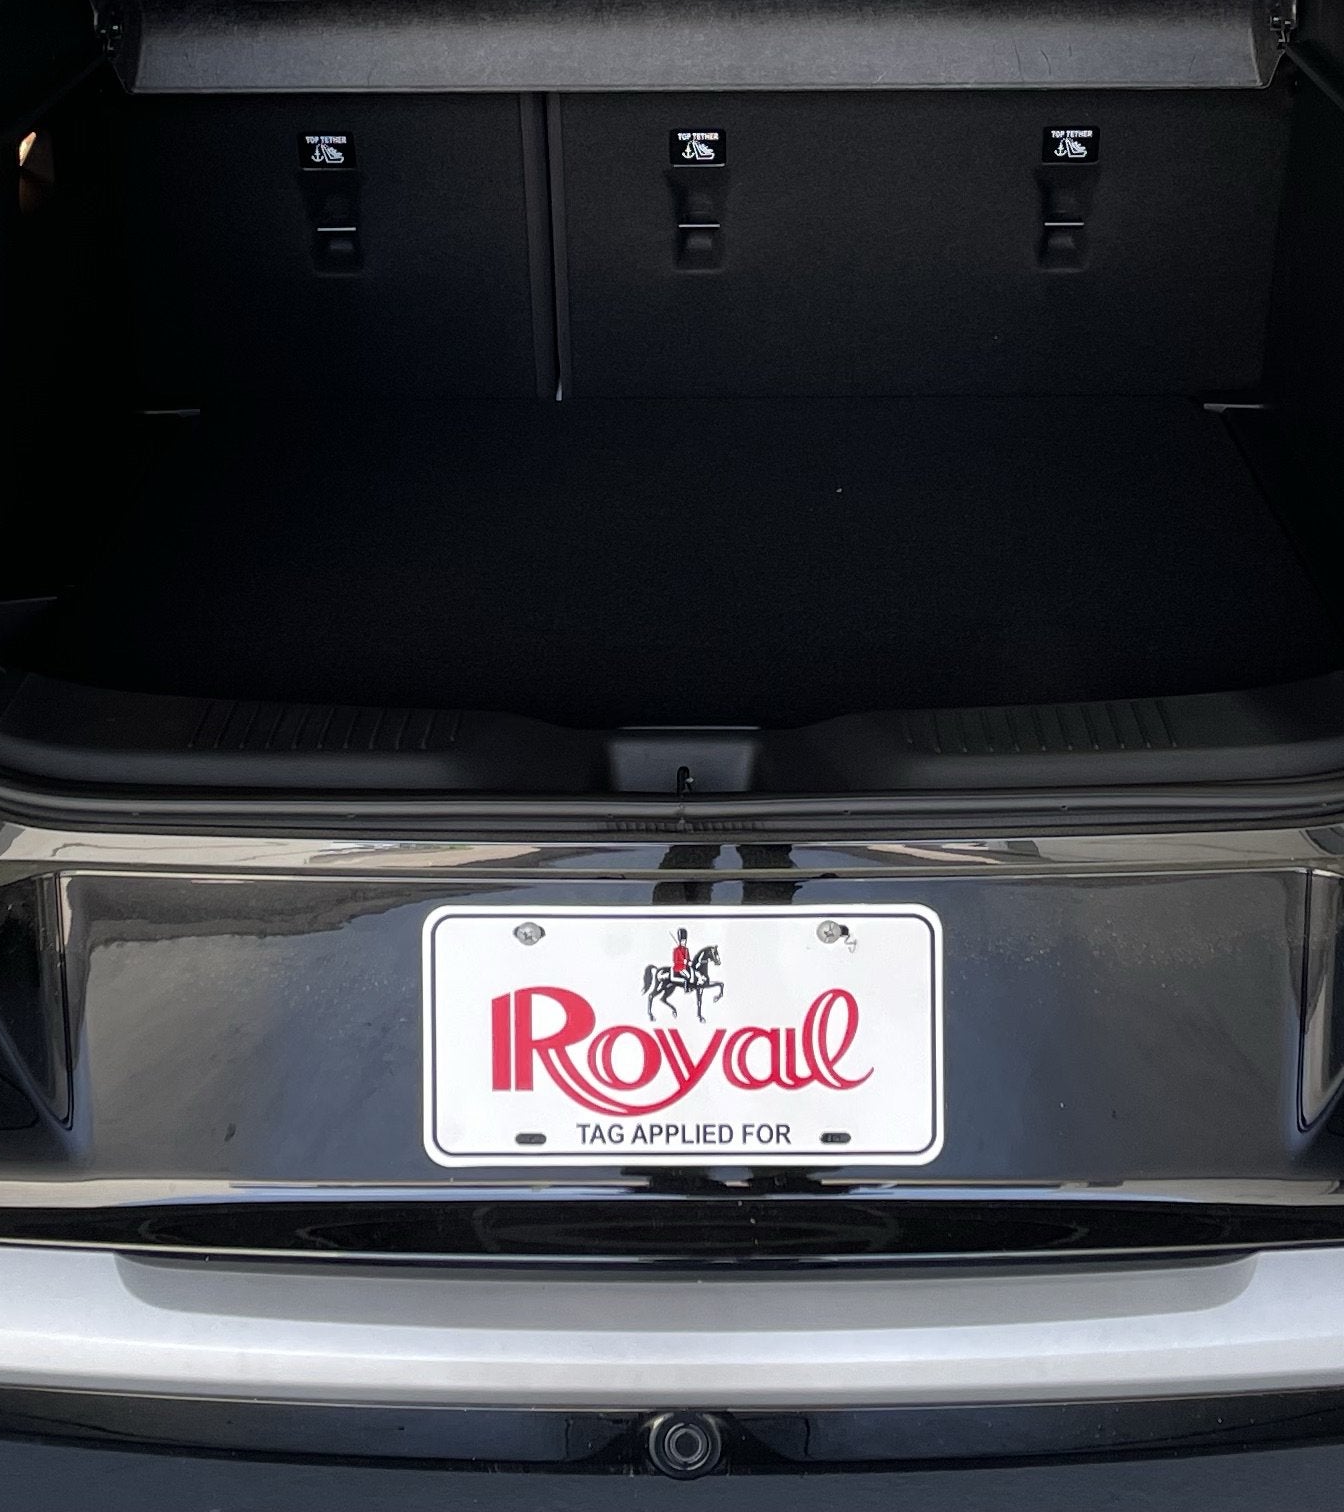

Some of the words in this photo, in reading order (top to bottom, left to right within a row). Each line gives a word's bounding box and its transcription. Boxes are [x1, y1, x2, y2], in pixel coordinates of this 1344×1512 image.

[677, 132, 691, 141] TOP
[692, 132, 719, 141] TETHER
[1050, 130, 1065, 138] TOP
[1066, 130, 1093, 138] TETHER
[305, 135, 319, 144] TOP
[320, 135, 347, 144] TETHER
[491, 985, 875, 1117] Royal
[576, 1123, 625, 1146] TAG
[631, 1123, 734, 1146] APPLIED
[742, 1123, 792, 1146] FOR
